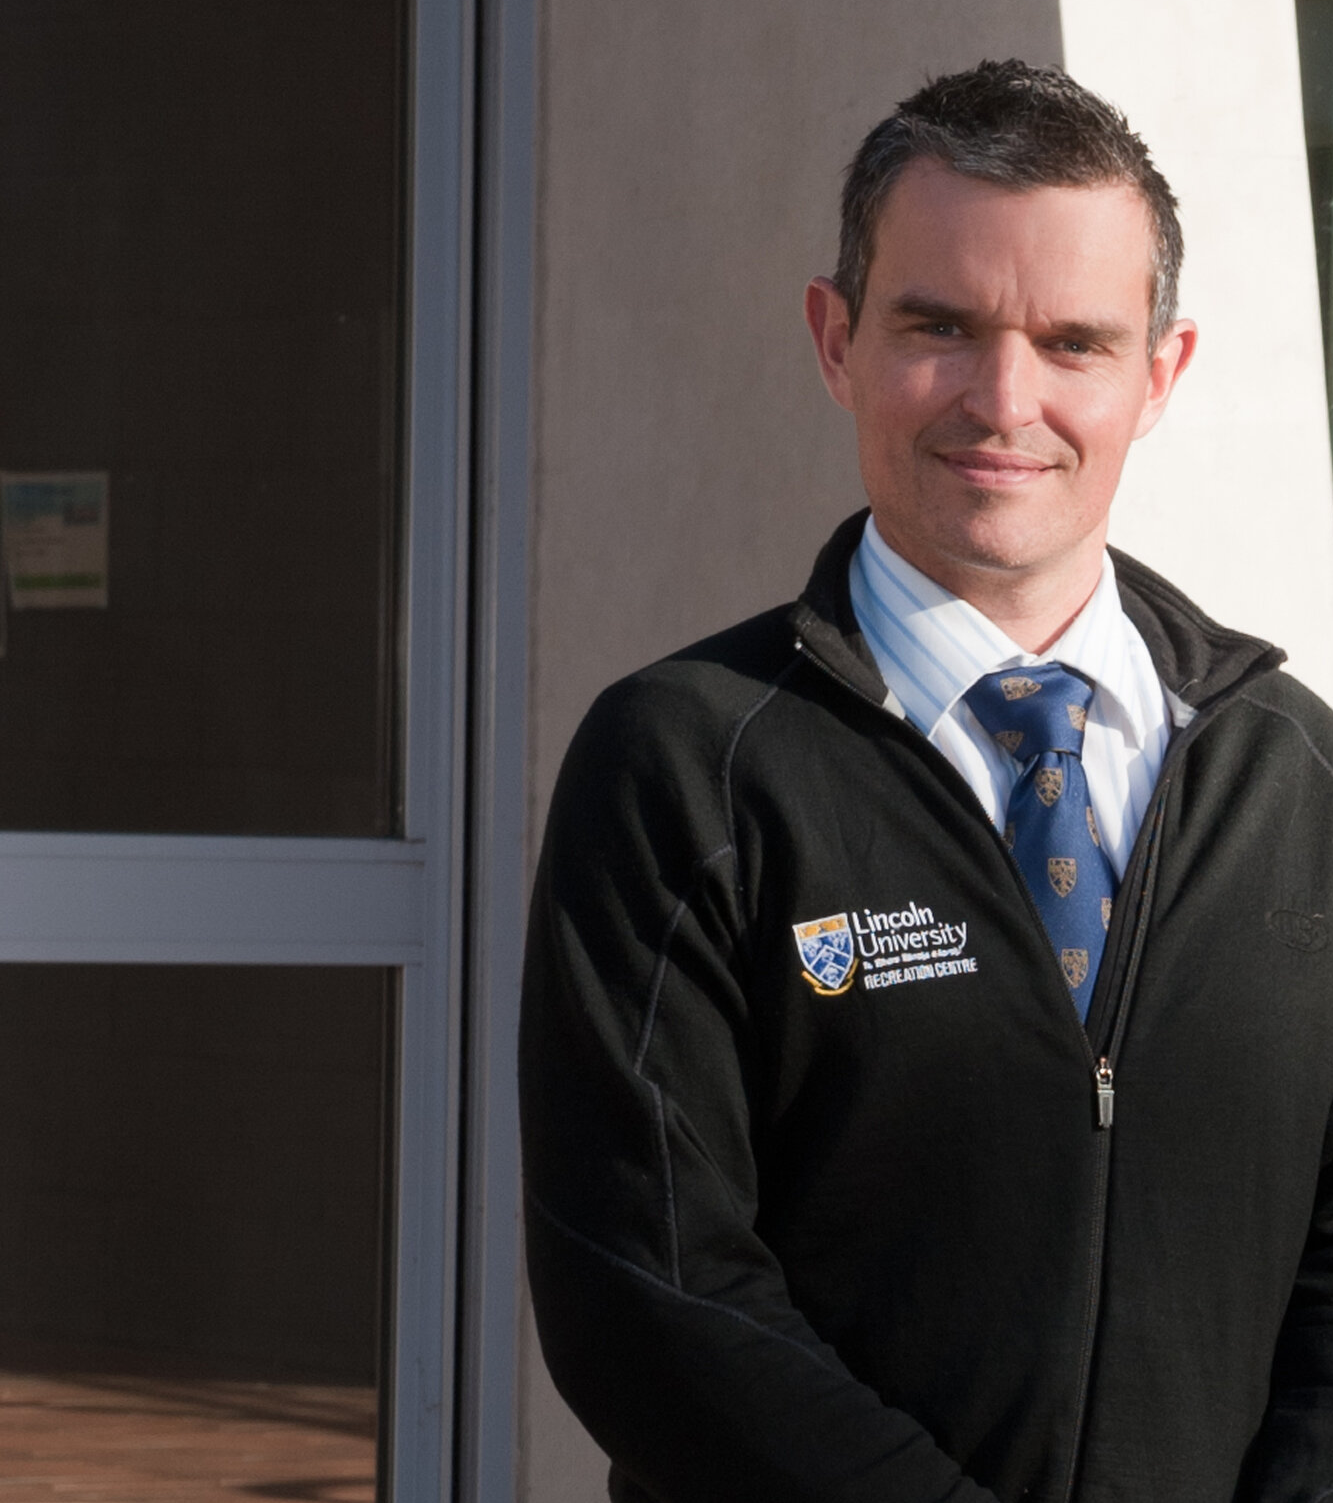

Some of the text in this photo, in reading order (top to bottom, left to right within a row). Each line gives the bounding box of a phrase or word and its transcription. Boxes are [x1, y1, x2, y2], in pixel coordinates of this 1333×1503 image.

[852, 901, 934, 935] Lincoln
[857, 922, 967, 957] University
[864, 964, 935, 990] RECREATION
[935, 957, 979, 978] CENTRE
